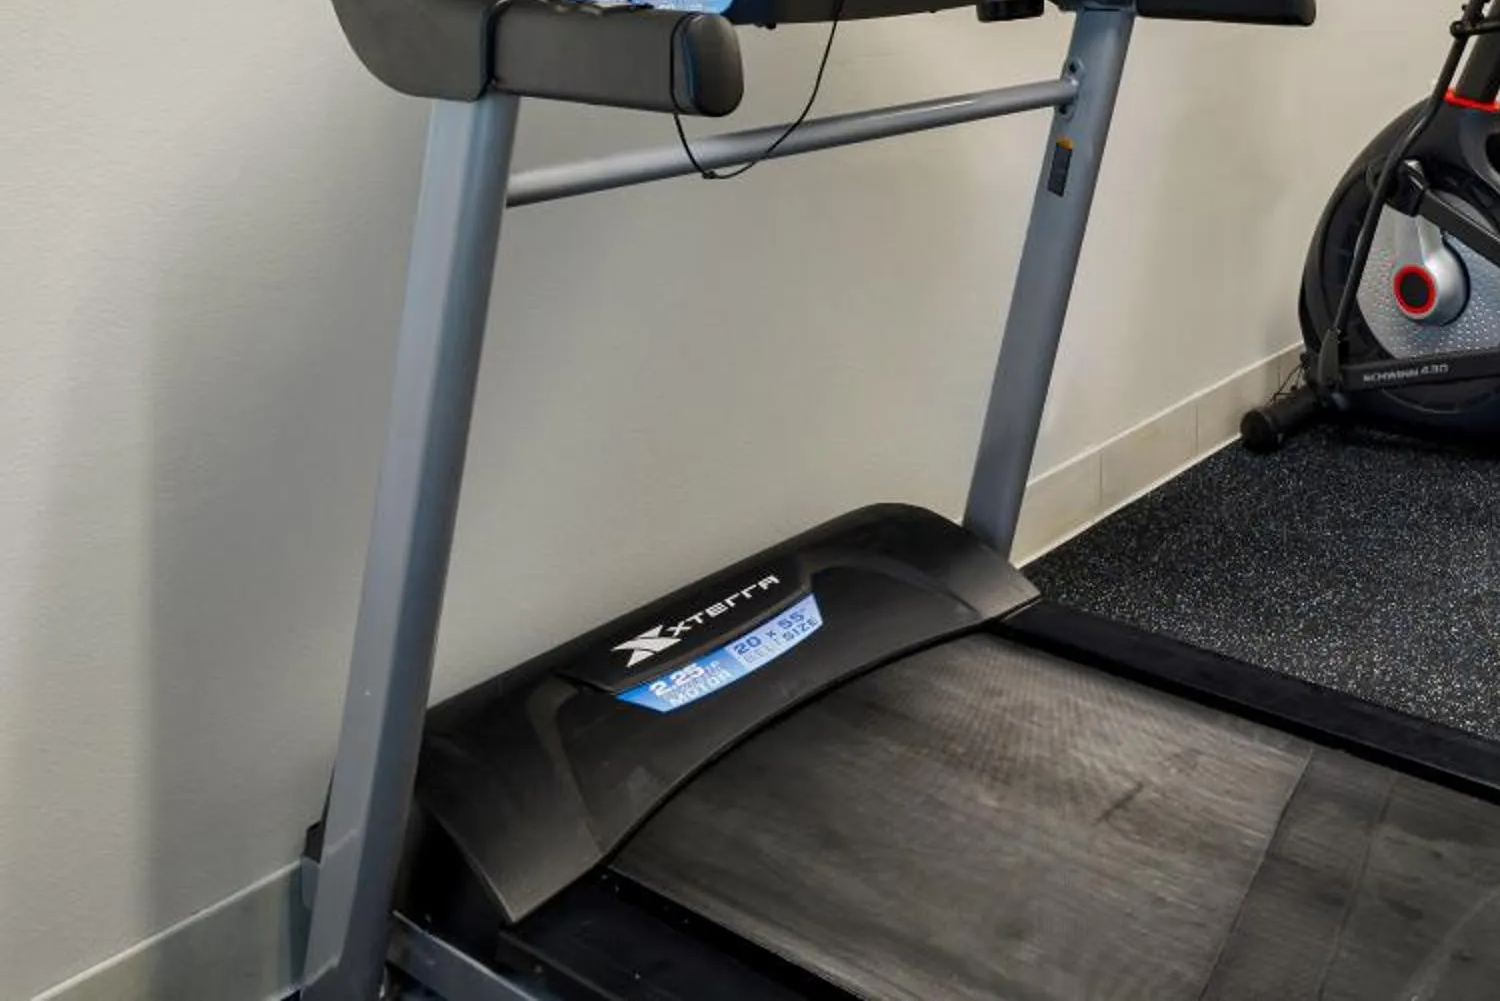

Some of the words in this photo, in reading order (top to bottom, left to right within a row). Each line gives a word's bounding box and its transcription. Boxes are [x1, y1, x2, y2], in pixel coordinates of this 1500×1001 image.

[667, 574, 780, 639] XTERRA
[733, 635, 763, 656] 20
[781, 615, 820, 642] SIZE
[649, 661, 706, 697] 2.25
[668, 669, 734, 708] MOTOR
